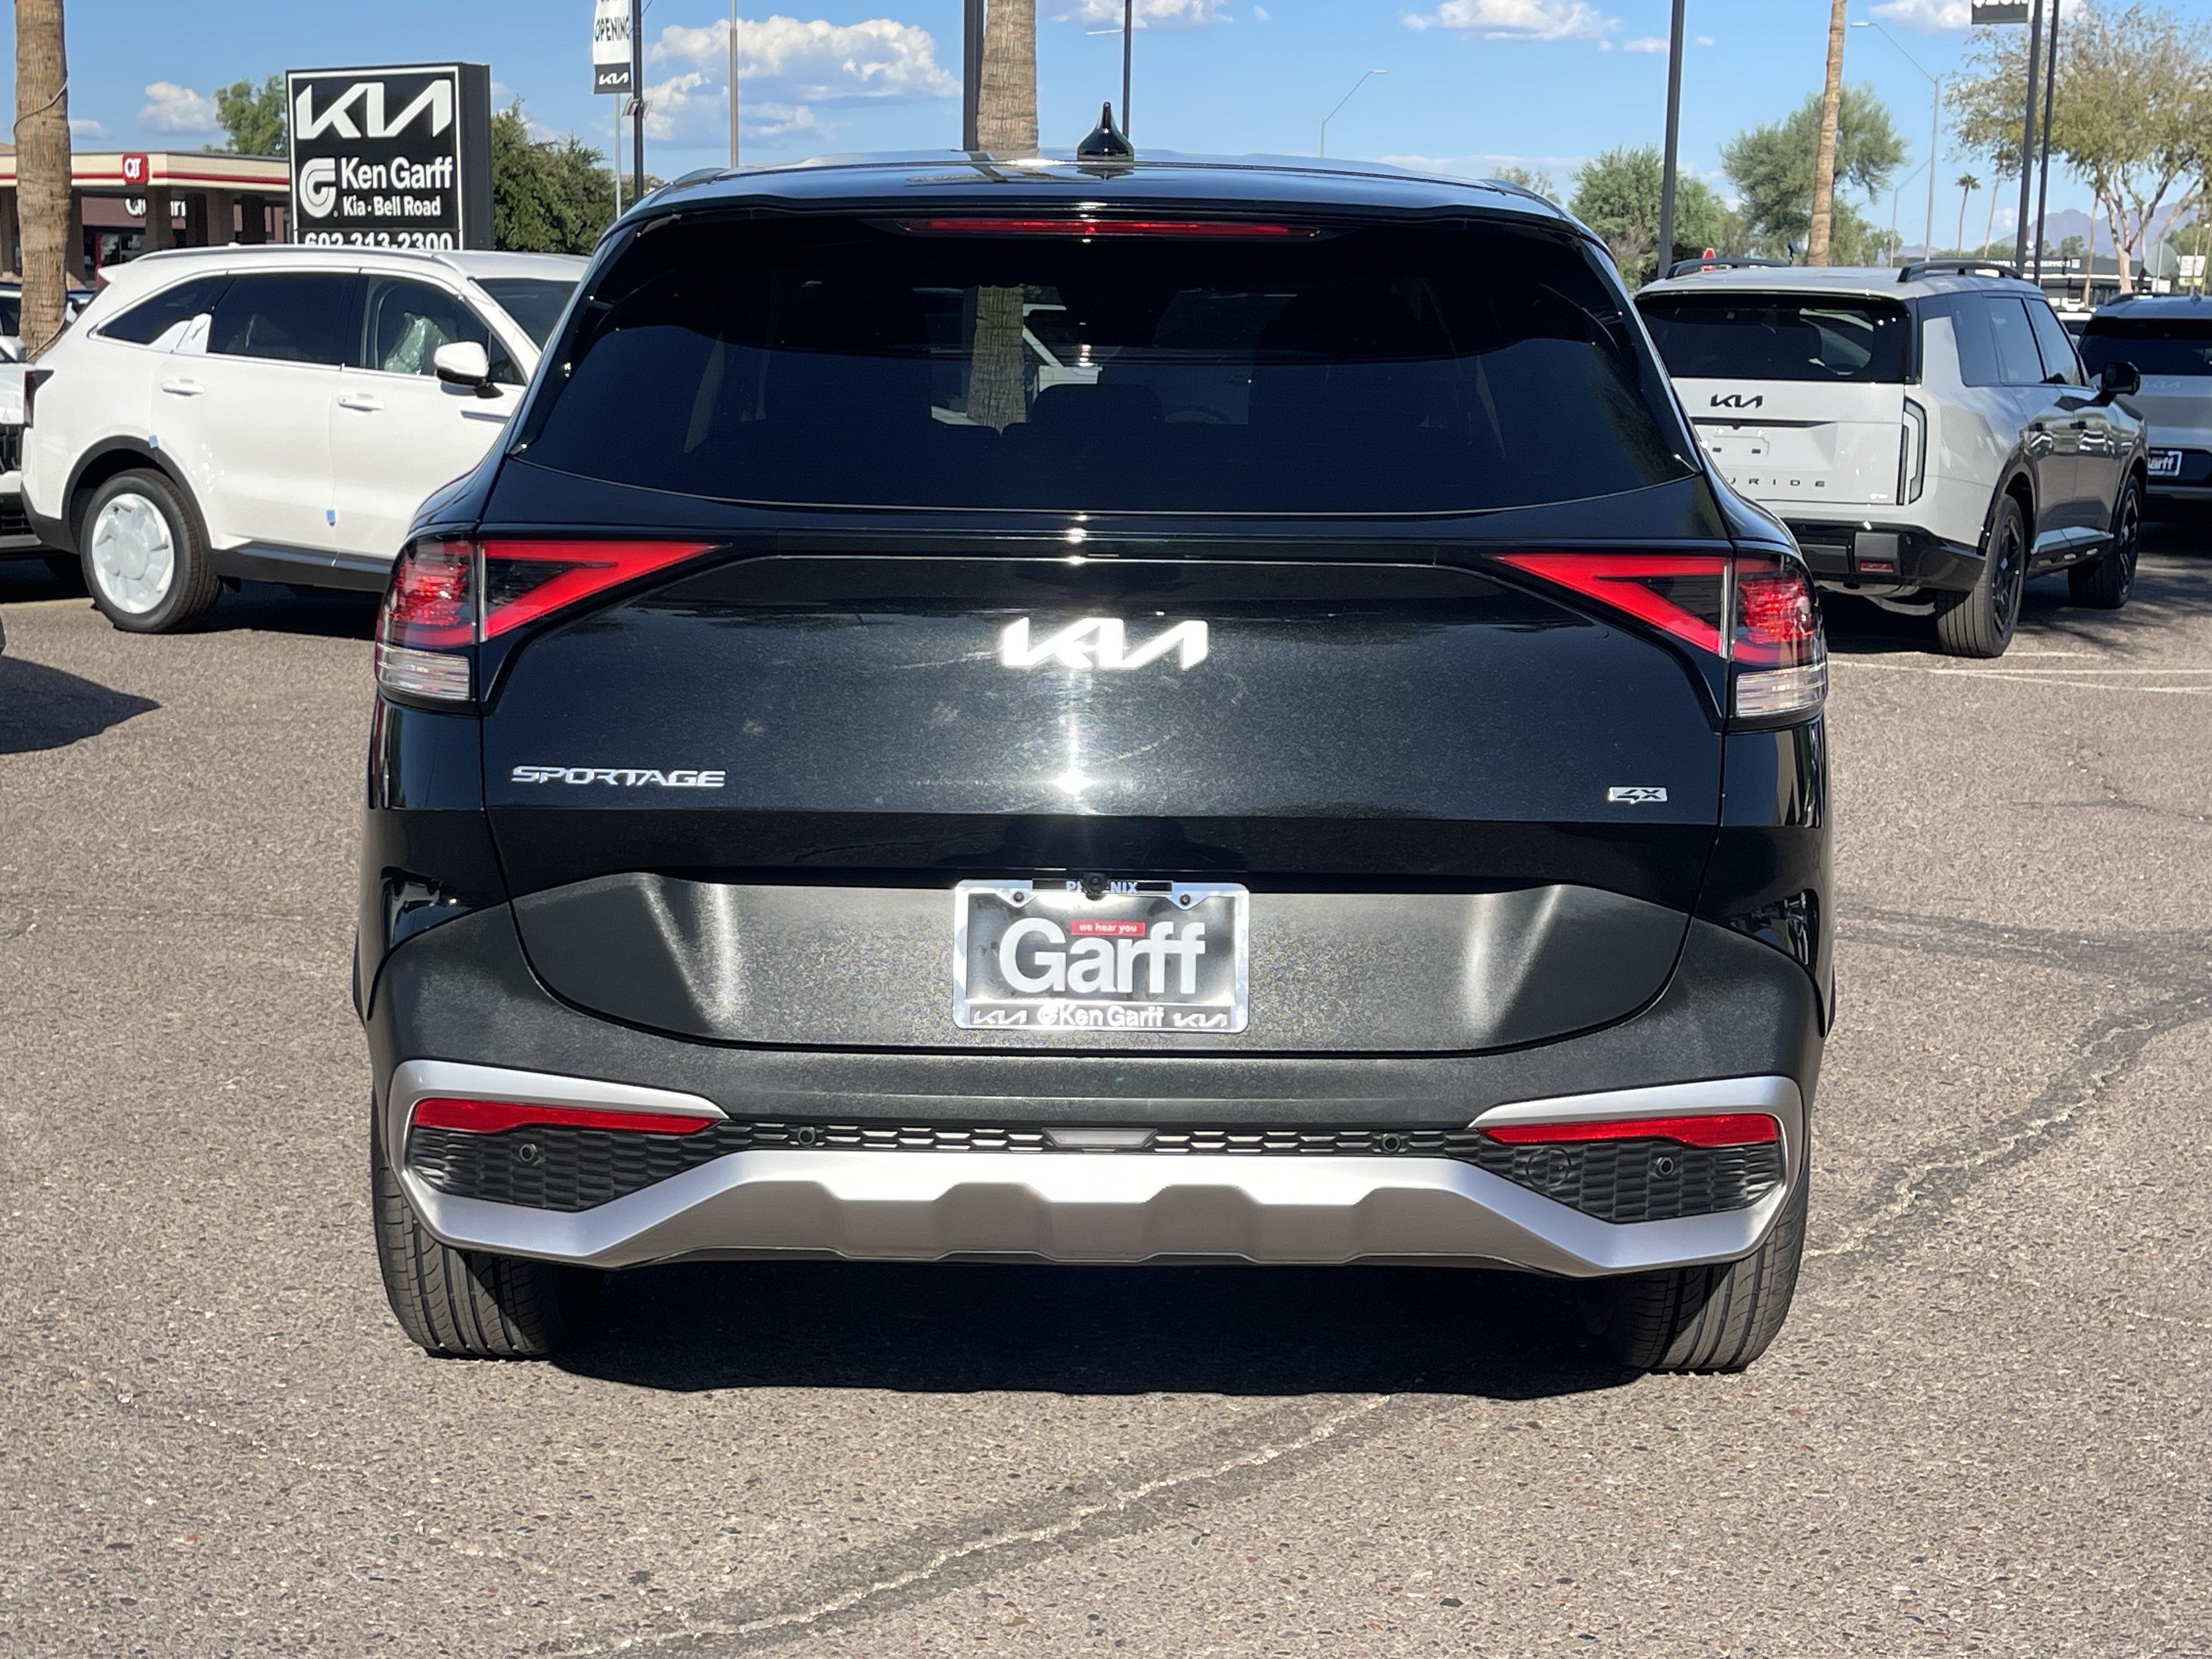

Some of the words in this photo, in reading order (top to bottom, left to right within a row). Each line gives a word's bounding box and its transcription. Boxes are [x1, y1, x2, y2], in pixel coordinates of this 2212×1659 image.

[595, 15, 629, 42] OPENING
[599, 72, 629, 85] KIA
[296, 79, 452, 139] KIA
[125, 157, 142, 179] QT
[341, 157, 387, 189] Ken
[390, 156, 453, 189] Garff
[343, 194, 366, 216] Kia
[373, 195, 400, 216] Bell
[404, 195, 441, 216] Road
[1710, 394, 1763, 408] KIA
[2149, 456, 2174, 470] arff
[1002, 617, 1208, 672] KIA
[511, 765, 727, 787] SPORTAGE
[1066, 880, 1138, 894] PNIX
[1079, 924, 1093, 932] we
[1095, 922, 1117, 932] hear
[1118, 924, 1138, 934] you
[999, 917, 1206, 994] Garff
[973, 1009, 1028, 1025] KIA
[1059, 1004, 1103, 1026] Ken
[1107, 1005, 1164, 1028] Garff
[1173, 1012, 1228, 1027] KIA
